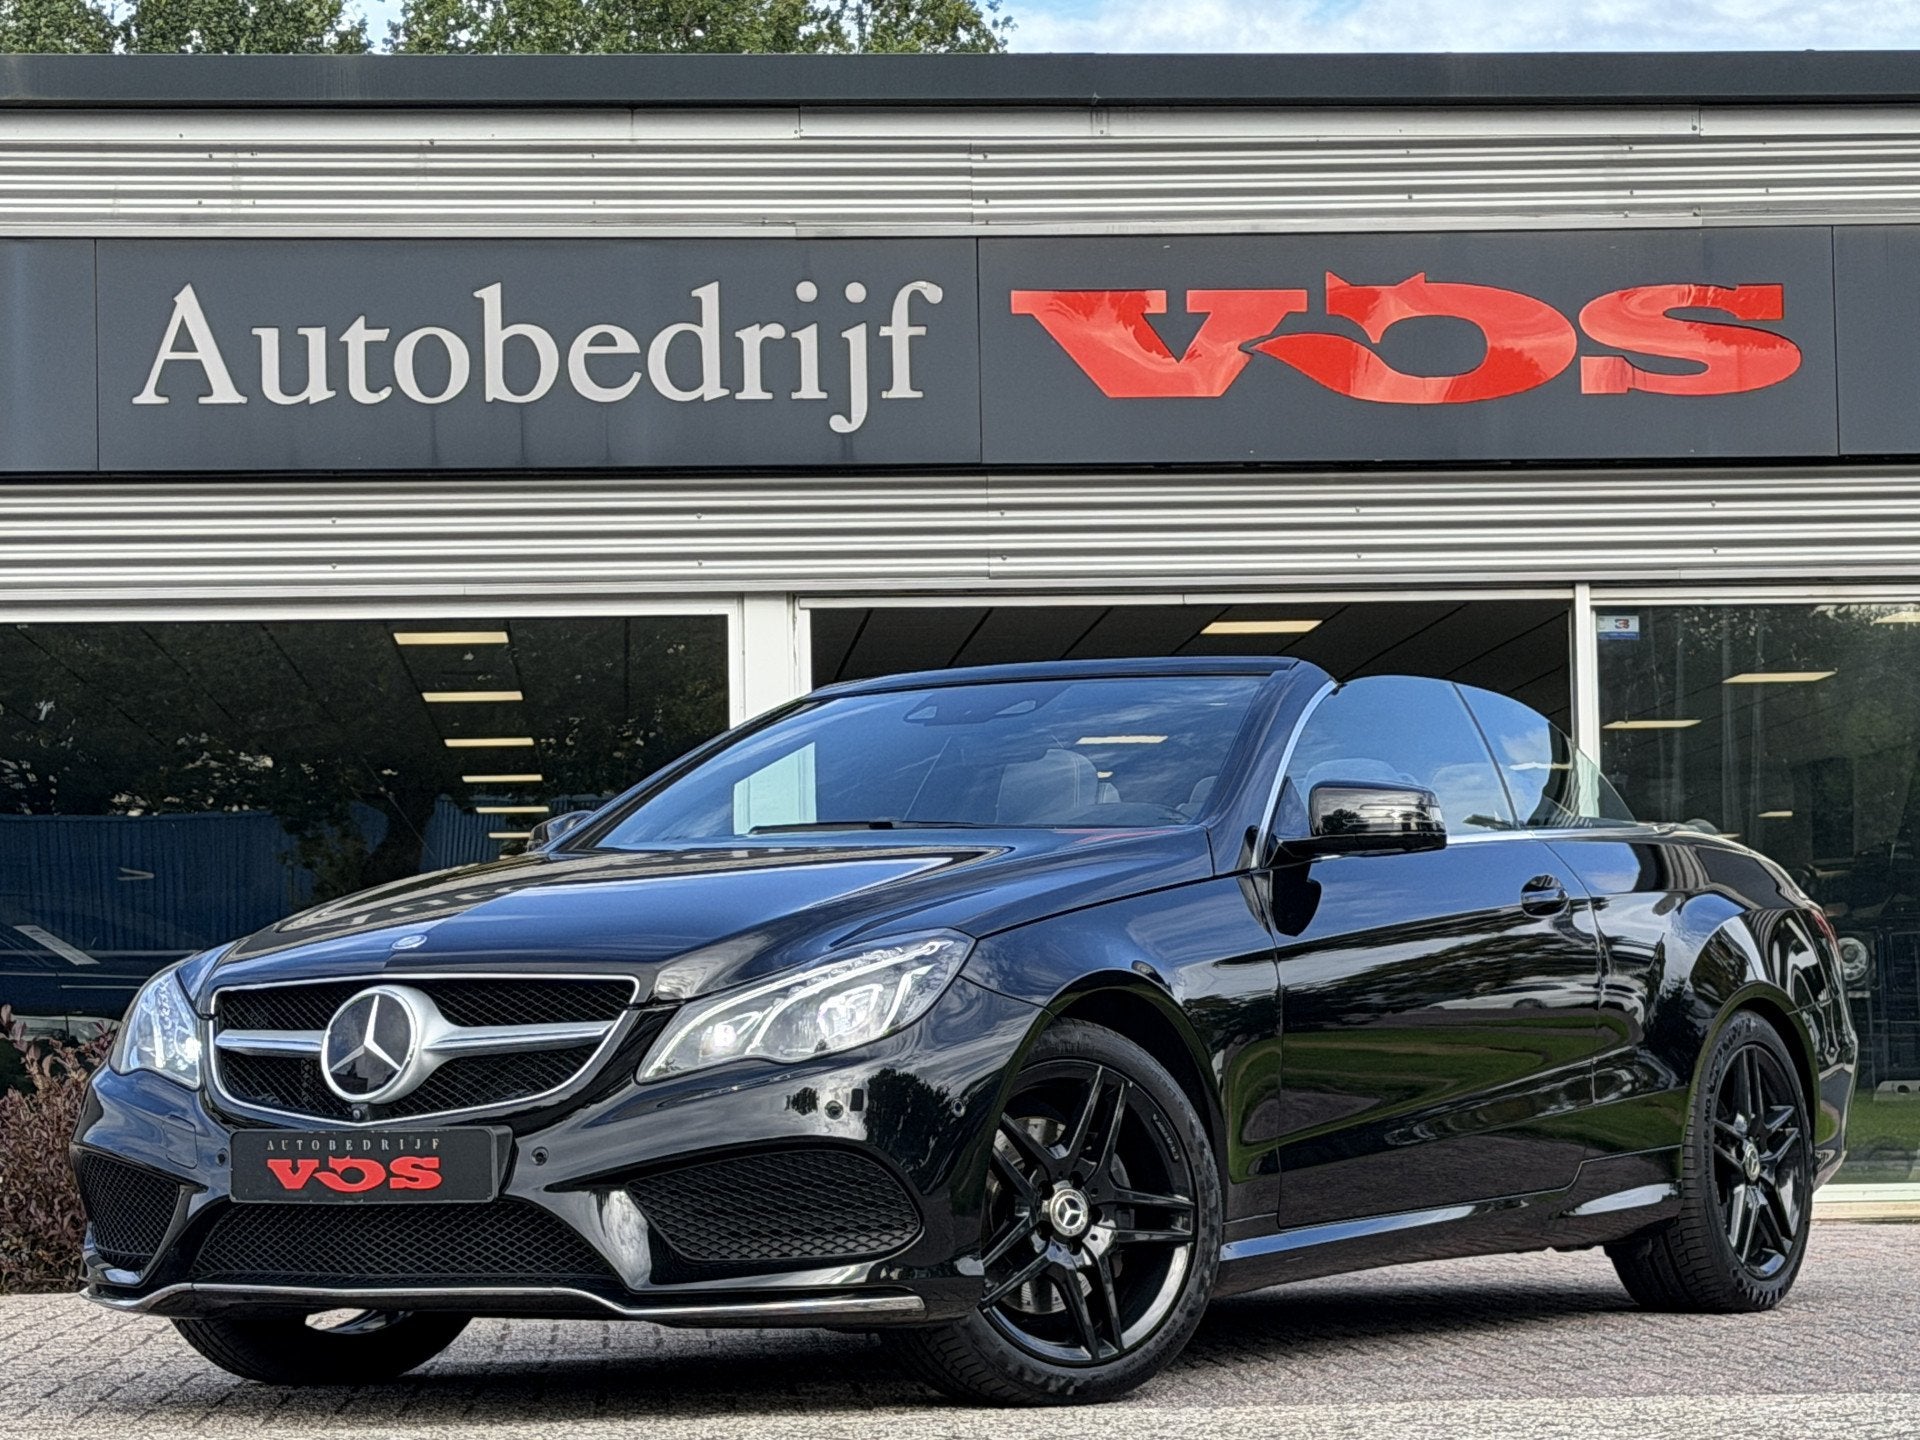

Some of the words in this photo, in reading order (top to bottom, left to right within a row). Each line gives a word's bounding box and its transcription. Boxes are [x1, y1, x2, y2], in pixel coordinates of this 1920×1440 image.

[133, 281, 942, 433] Autobedrijf
[1011, 271, 1802, 404] VOS
[267, 1138, 440, 1151] AUTOBEDRIJF
[267, 1156, 443, 1193] VOS
